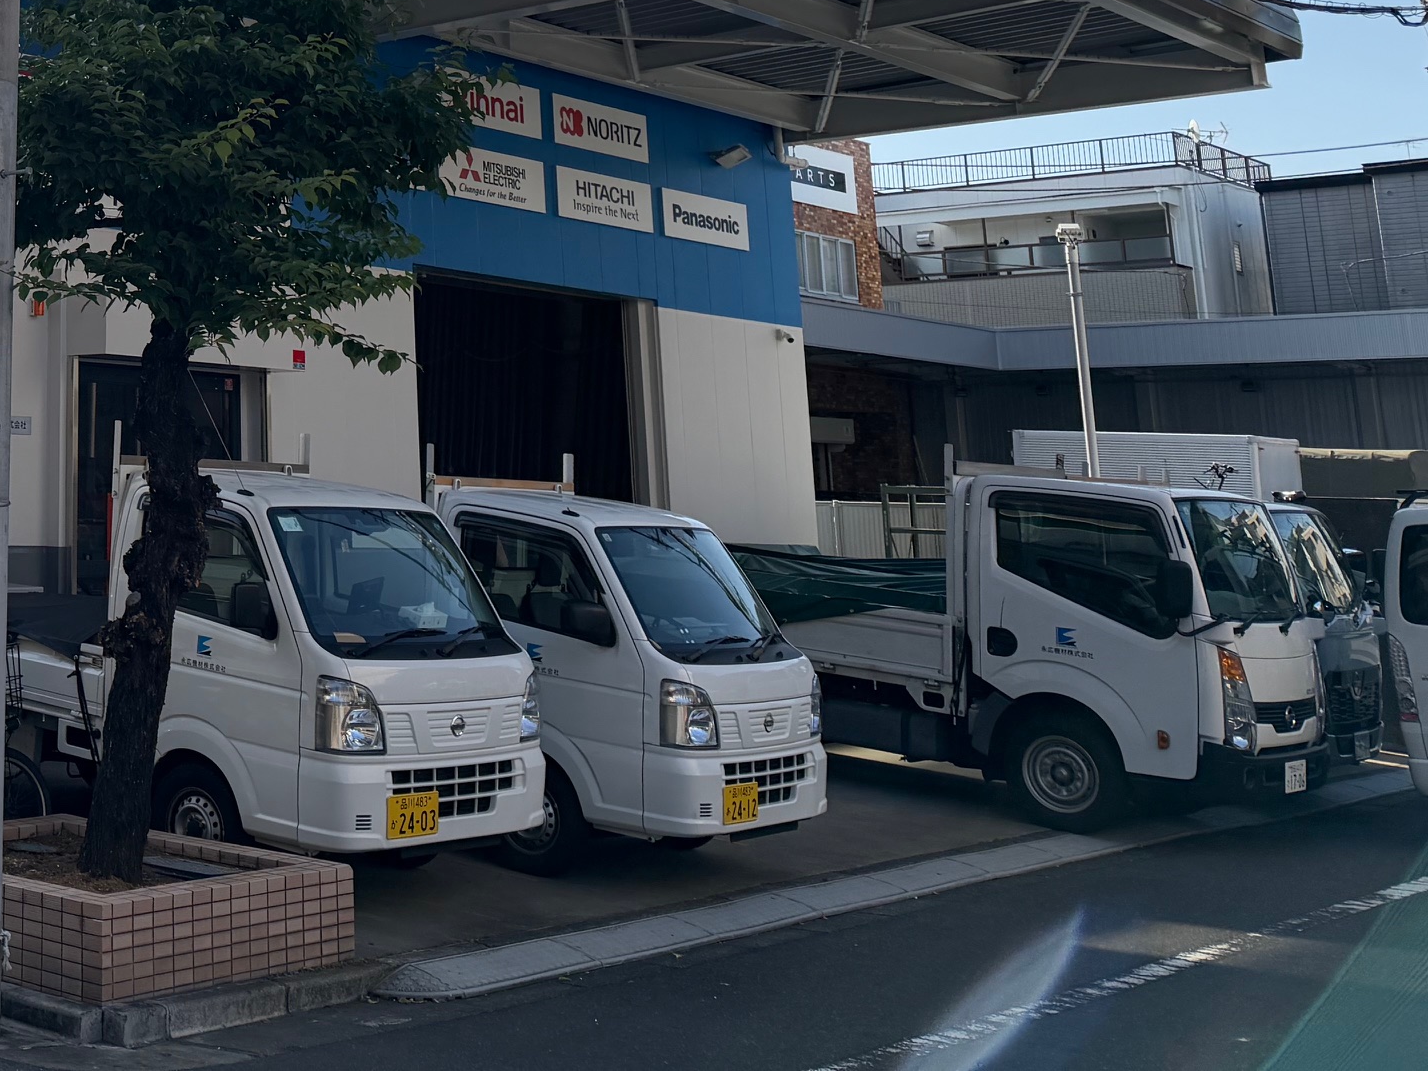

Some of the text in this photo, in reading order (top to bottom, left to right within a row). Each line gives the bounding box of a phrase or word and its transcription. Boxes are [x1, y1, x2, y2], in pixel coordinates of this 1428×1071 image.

[462, 91, 525, 124] innai
[586, 115, 643, 148] NORITZ
[482, 160, 527, 180] MITSUBISHI
[483, 172, 522, 191] ELECTRIC
[459, 182, 486, 197] Changes
[486, 189, 497, 200] for
[575, 179, 636, 208] HITACHI
[573, 198, 640, 222] Inspire the Next
[672, 203, 740, 236] Panasonic
[415, 795, 428, 808] 483
[732, 798, 757, 821] 24-12
[399, 809, 436, 835] 24-03
